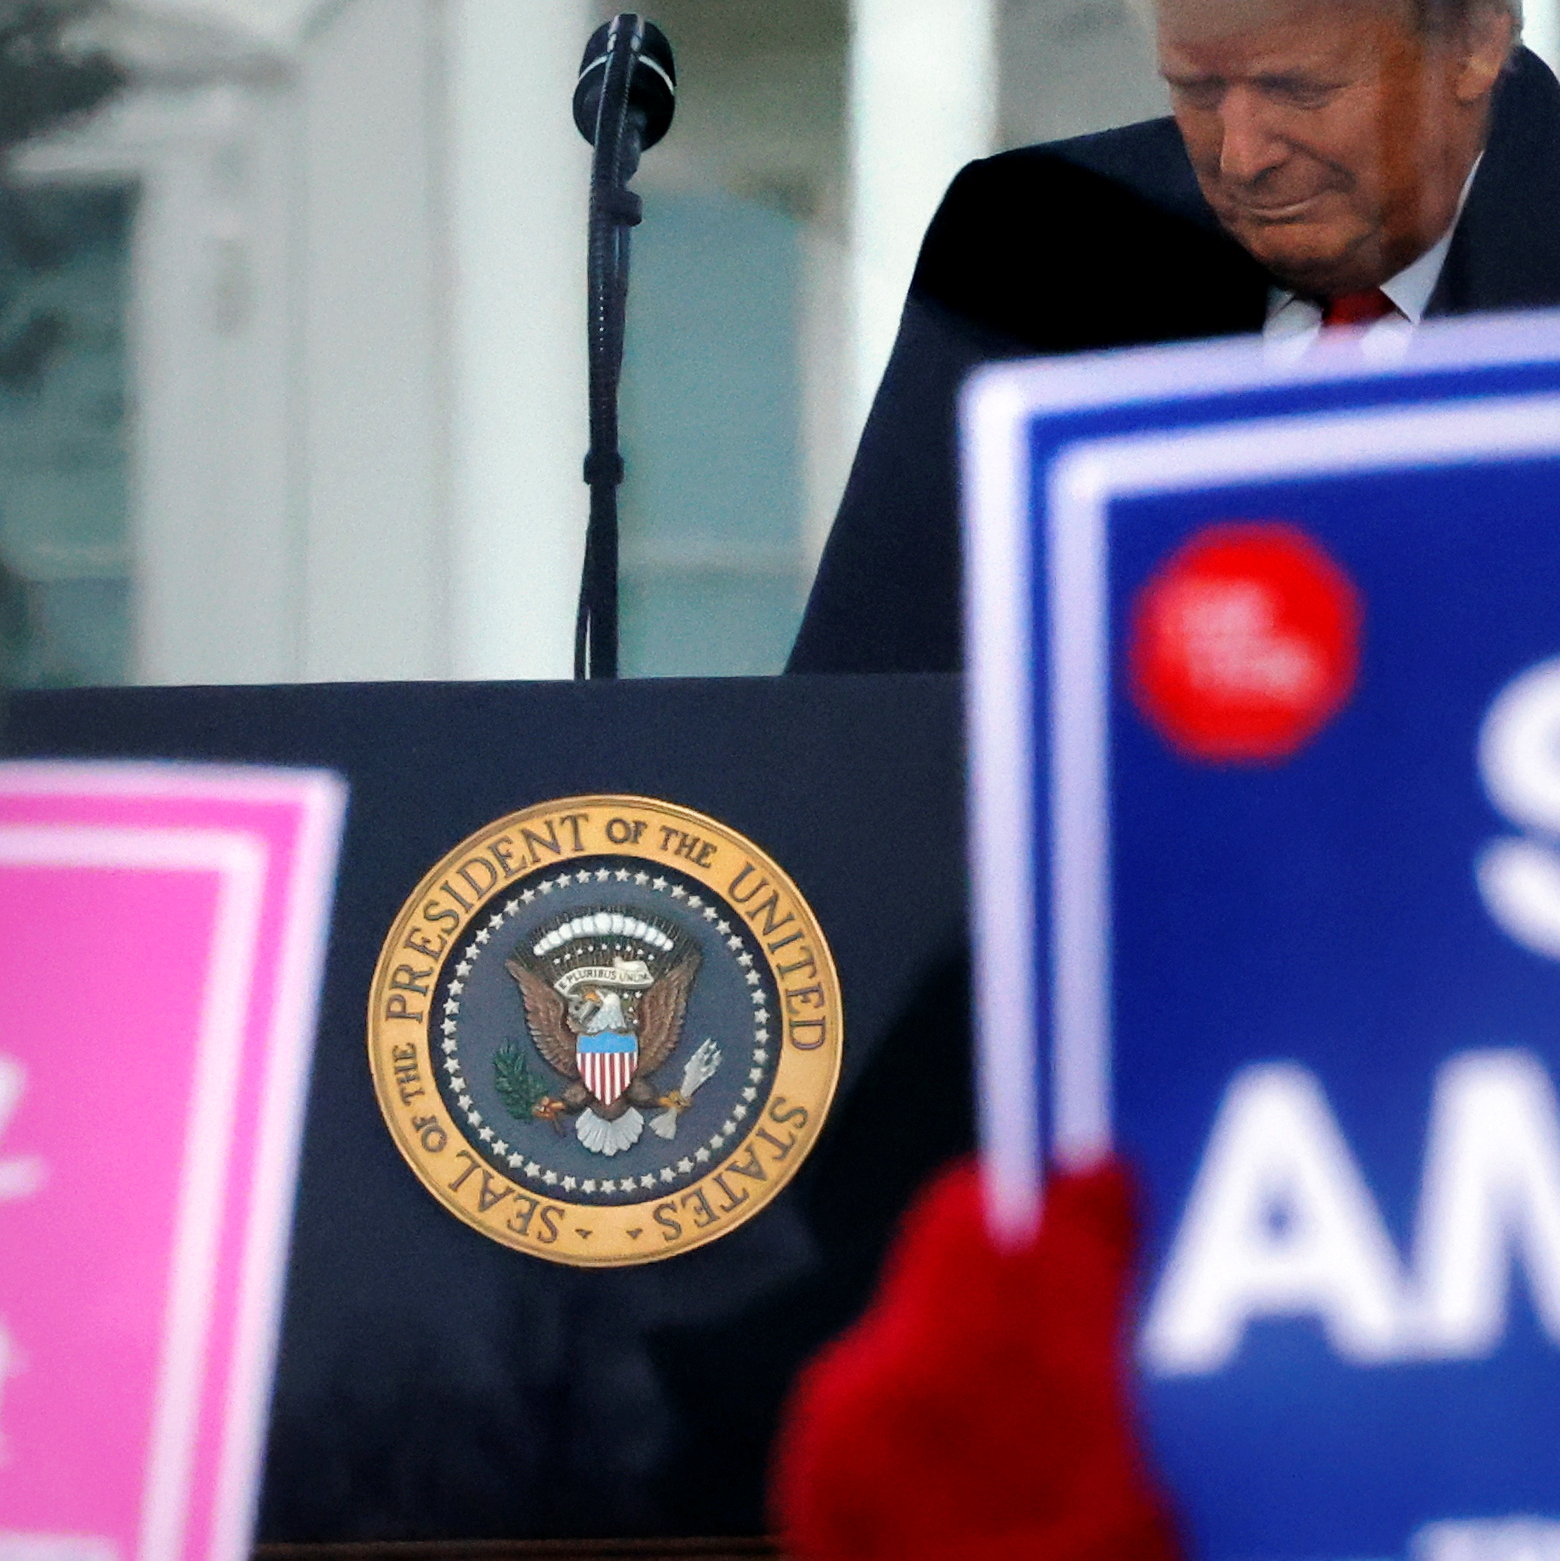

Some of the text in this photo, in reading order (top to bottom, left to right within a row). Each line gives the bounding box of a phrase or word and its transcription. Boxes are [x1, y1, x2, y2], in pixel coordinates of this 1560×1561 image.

[385, 812, 828, 1244] SEAL OF THE PRESIDENT OF THE UNITED STATES
